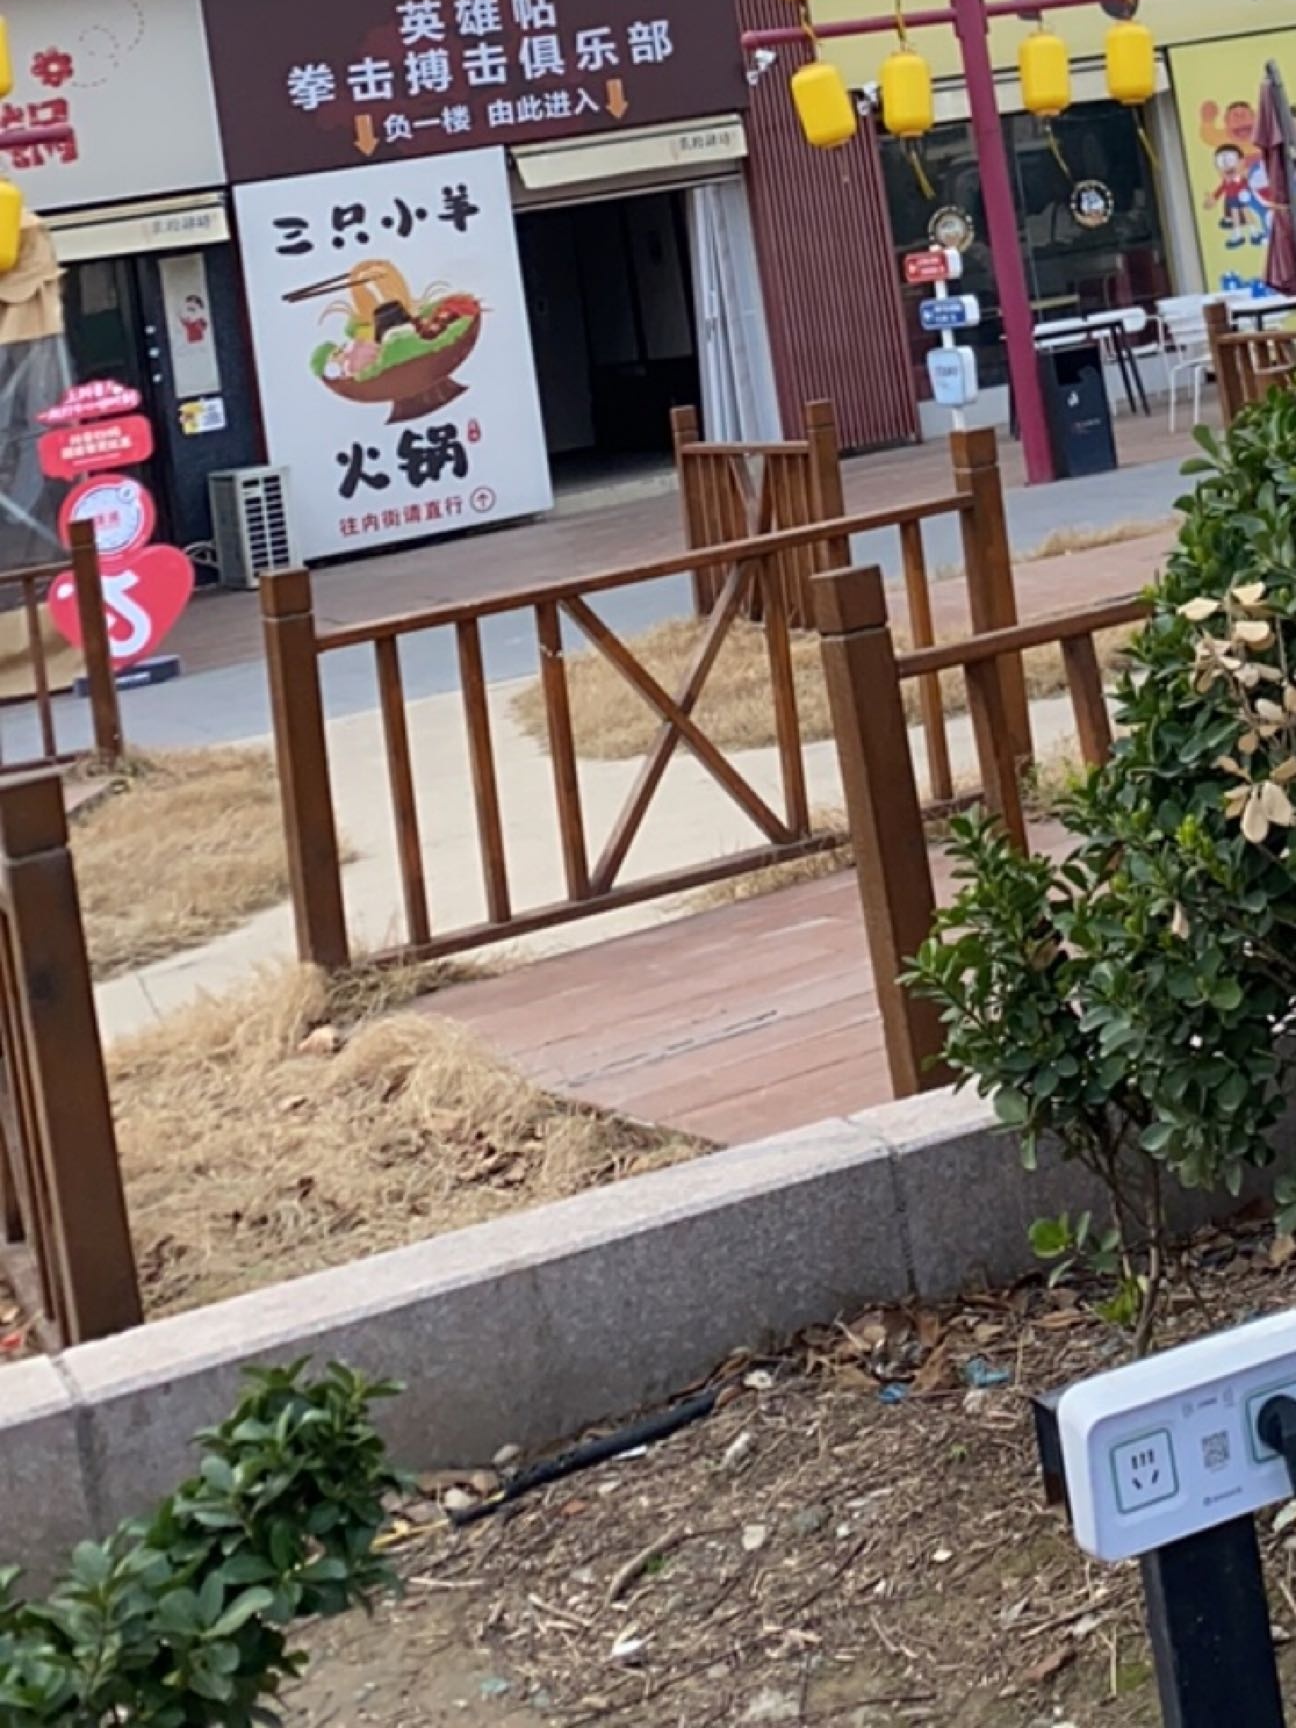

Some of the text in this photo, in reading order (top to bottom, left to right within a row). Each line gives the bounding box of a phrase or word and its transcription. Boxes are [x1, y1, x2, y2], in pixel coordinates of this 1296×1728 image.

[286, 18, 674, 113] 拳击搏击俱乐部
[382, 87, 599, 142] 负一楼 由此进入
[271, 182, 480, 256] 三只小羊
[335, 421, 469, 499] 火锅
[338, 495, 463, 538] 往内街请直行
